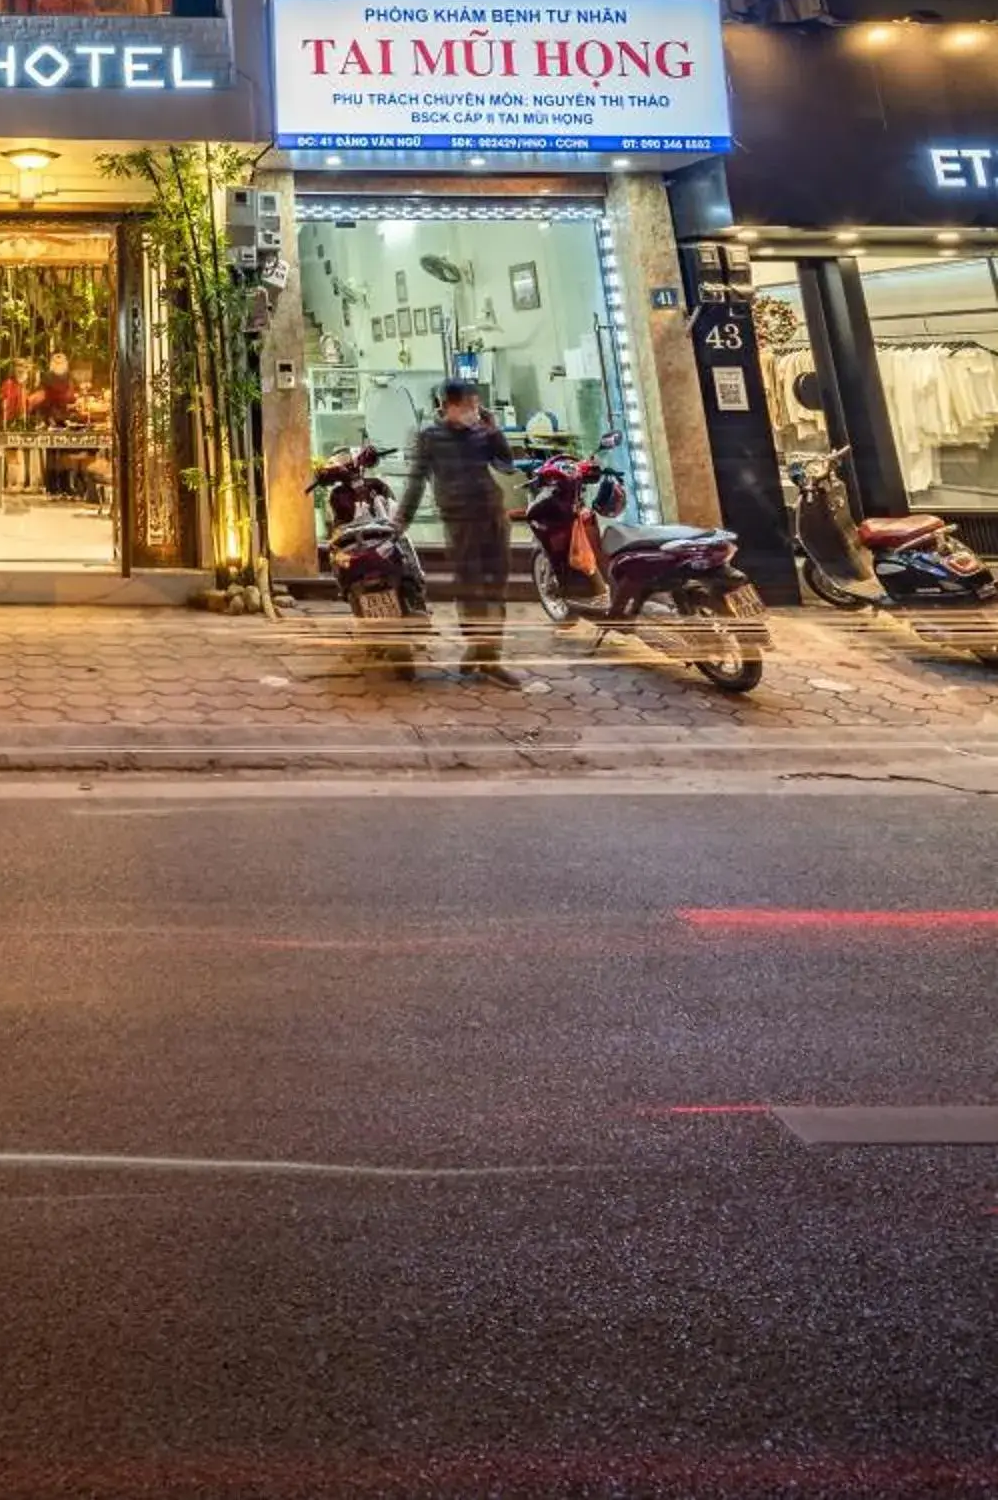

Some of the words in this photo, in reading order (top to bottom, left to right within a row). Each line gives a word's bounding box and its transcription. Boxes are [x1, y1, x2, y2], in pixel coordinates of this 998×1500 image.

[302, 39, 393, 75] TAI
[413, 29, 520, 77] MŨI
[533, 39, 695, 87] HỌNG
[411, 111, 450, 123] BSCK
[498, 113, 519, 124] TAI
[930, 149, 998, 189] ET
[655, 291, 673, 306] 41
[705, 323, 743, 349] 43
